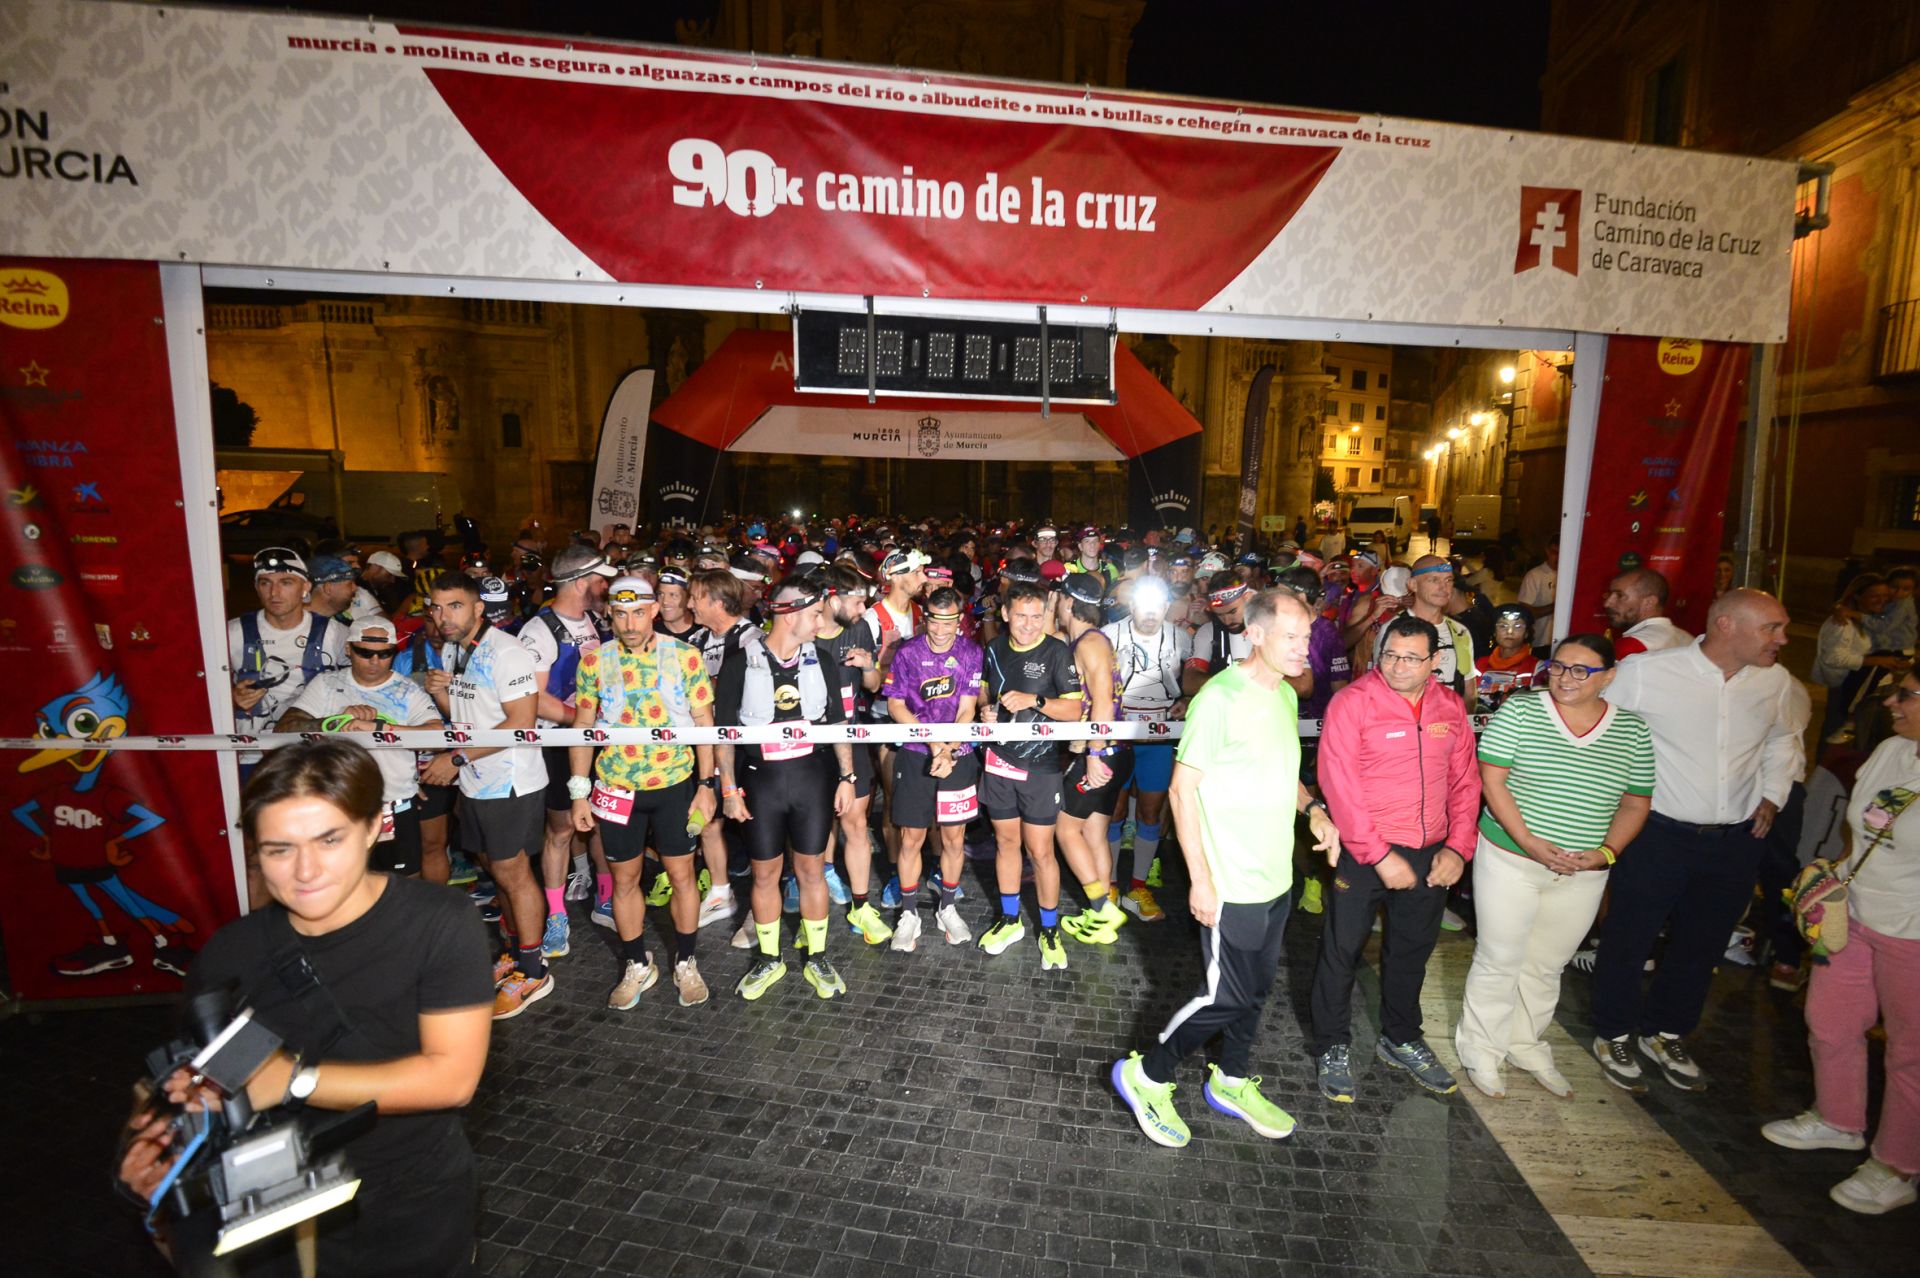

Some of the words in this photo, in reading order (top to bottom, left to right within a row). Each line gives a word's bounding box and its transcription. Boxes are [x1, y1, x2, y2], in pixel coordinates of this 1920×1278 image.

[288, 34, 377, 53] murcia
[402, 44, 490, 63] molina
[496, 51, 524, 67] de
[529, 56, 611, 74] segura
[629, 64, 732, 84] alguazas
[749, 75, 833, 94] campos
[838, 82, 871, 98] del
[875, 86, 905, 102] río
[921, 92, 1020, 112] albudeite
[1035, 102, 1087, 117] mula
[1103, 107, 1163, 125] bullas
[1177, 115, 1251, 135] cehegín
[1269, 124, 1348, 140] caravaca
[1352, 129, 1372, 143] de
[1375, 131, 1391, 144] la
[1394, 136, 1432, 149] cruz
[0, 145, 139, 186] URCIA
[667, 137, 804, 218] 90k
[815, 165, 965, 221] camino
[975, 171, 1020, 224] de
[1030, 176, 1066, 228] la
[1076, 190, 1157, 232] cruz
[1594, 193, 1697, 223] Fundación
[1593, 220, 1665, 247] Camino
[1669, 228, 1693, 249] de
[1698, 230, 1713, 251] la
[1718, 232, 1761, 256] Cruz
[1591, 248, 1613, 270] de
[1617, 251, 1704, 278] Caravaca
[1661, 352, 1695, 366] Reina
[853, 432, 901, 442] MURCIA
[943, 430, 1002, 441] Ayuntamiento
[943, 441, 954, 449] de
[955, 441, 988, 450] Murcia
[614, 416, 628, 486] Ayuntamiento
[627, 435, 638, 473] Murcia
[625, 474, 634, 488] de
[508, 673, 533, 686] 42K
[444, 730, 473, 743] 90k
[514, 730, 542, 742] 90k
[583, 729, 611, 742] 90k
[651, 728, 677, 741] 90k
[718, 727, 743, 741] 90k
[782, 727, 807, 739] 90k
[847, 727, 871, 739] 90k
[971, 725, 993, 737] 90k
[1031, 723, 1054, 736] 90k
[1090, 722, 1113, 735] 90k
[1148, 722, 1171, 735] 90k
[596, 793, 618, 810] 264
[949, 800, 970, 813] 260
[54, 805, 103, 829] 90k
